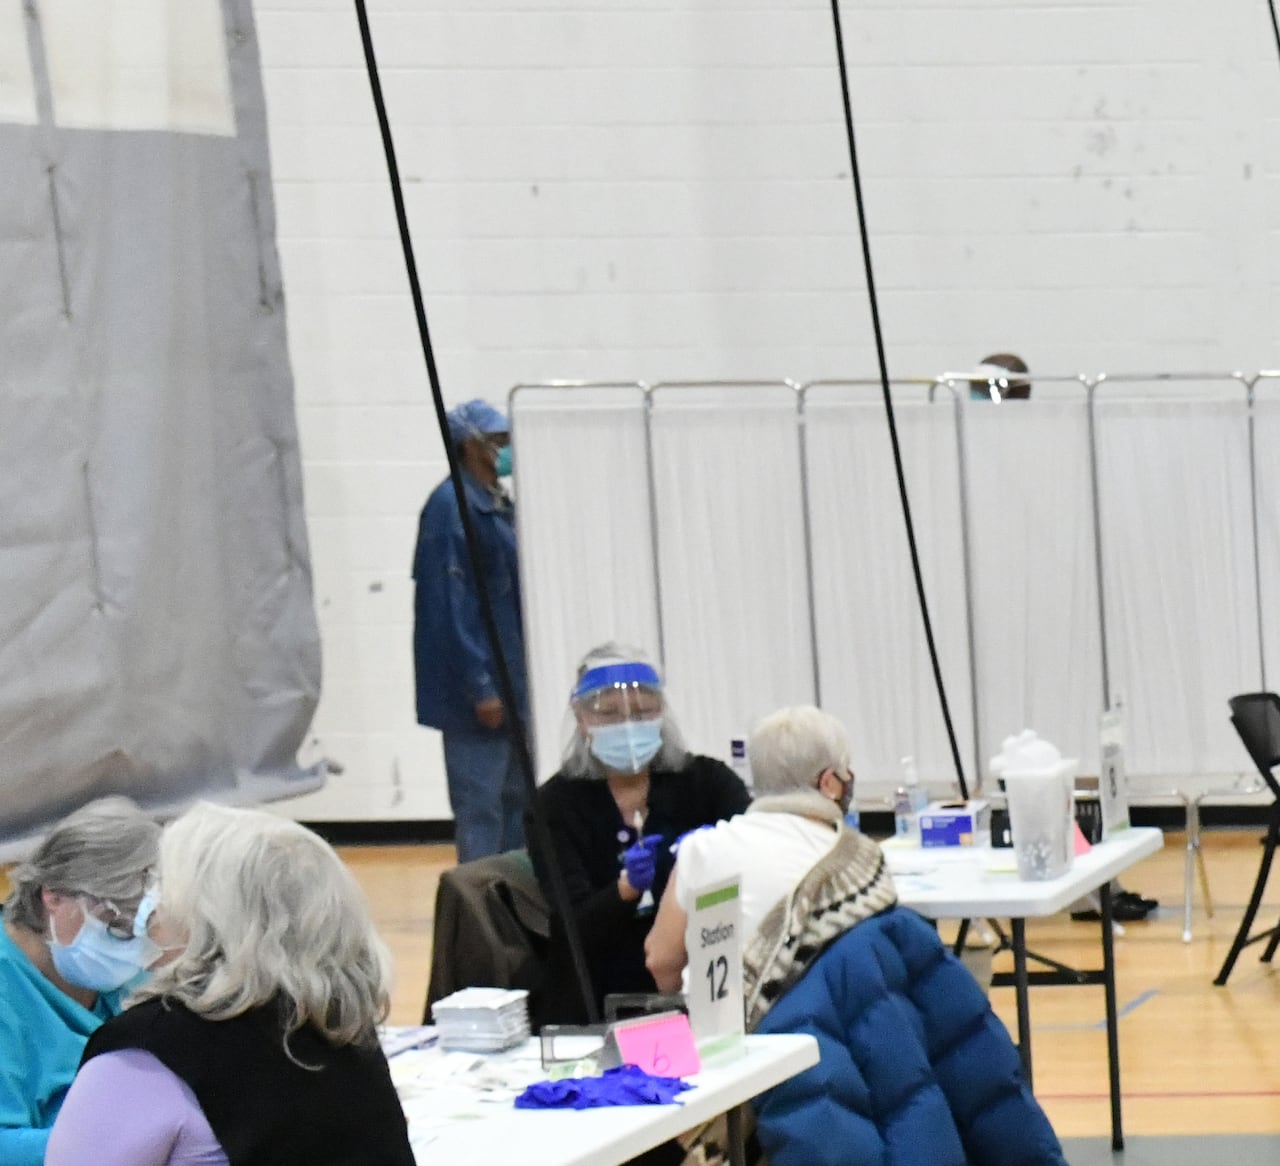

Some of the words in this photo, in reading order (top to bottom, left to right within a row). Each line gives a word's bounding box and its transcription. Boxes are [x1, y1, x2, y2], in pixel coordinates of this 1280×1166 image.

[700, 922, 735, 948] Station
[706, 954, 729, 1003] 12
[652, 1040, 671, 1074] 6
